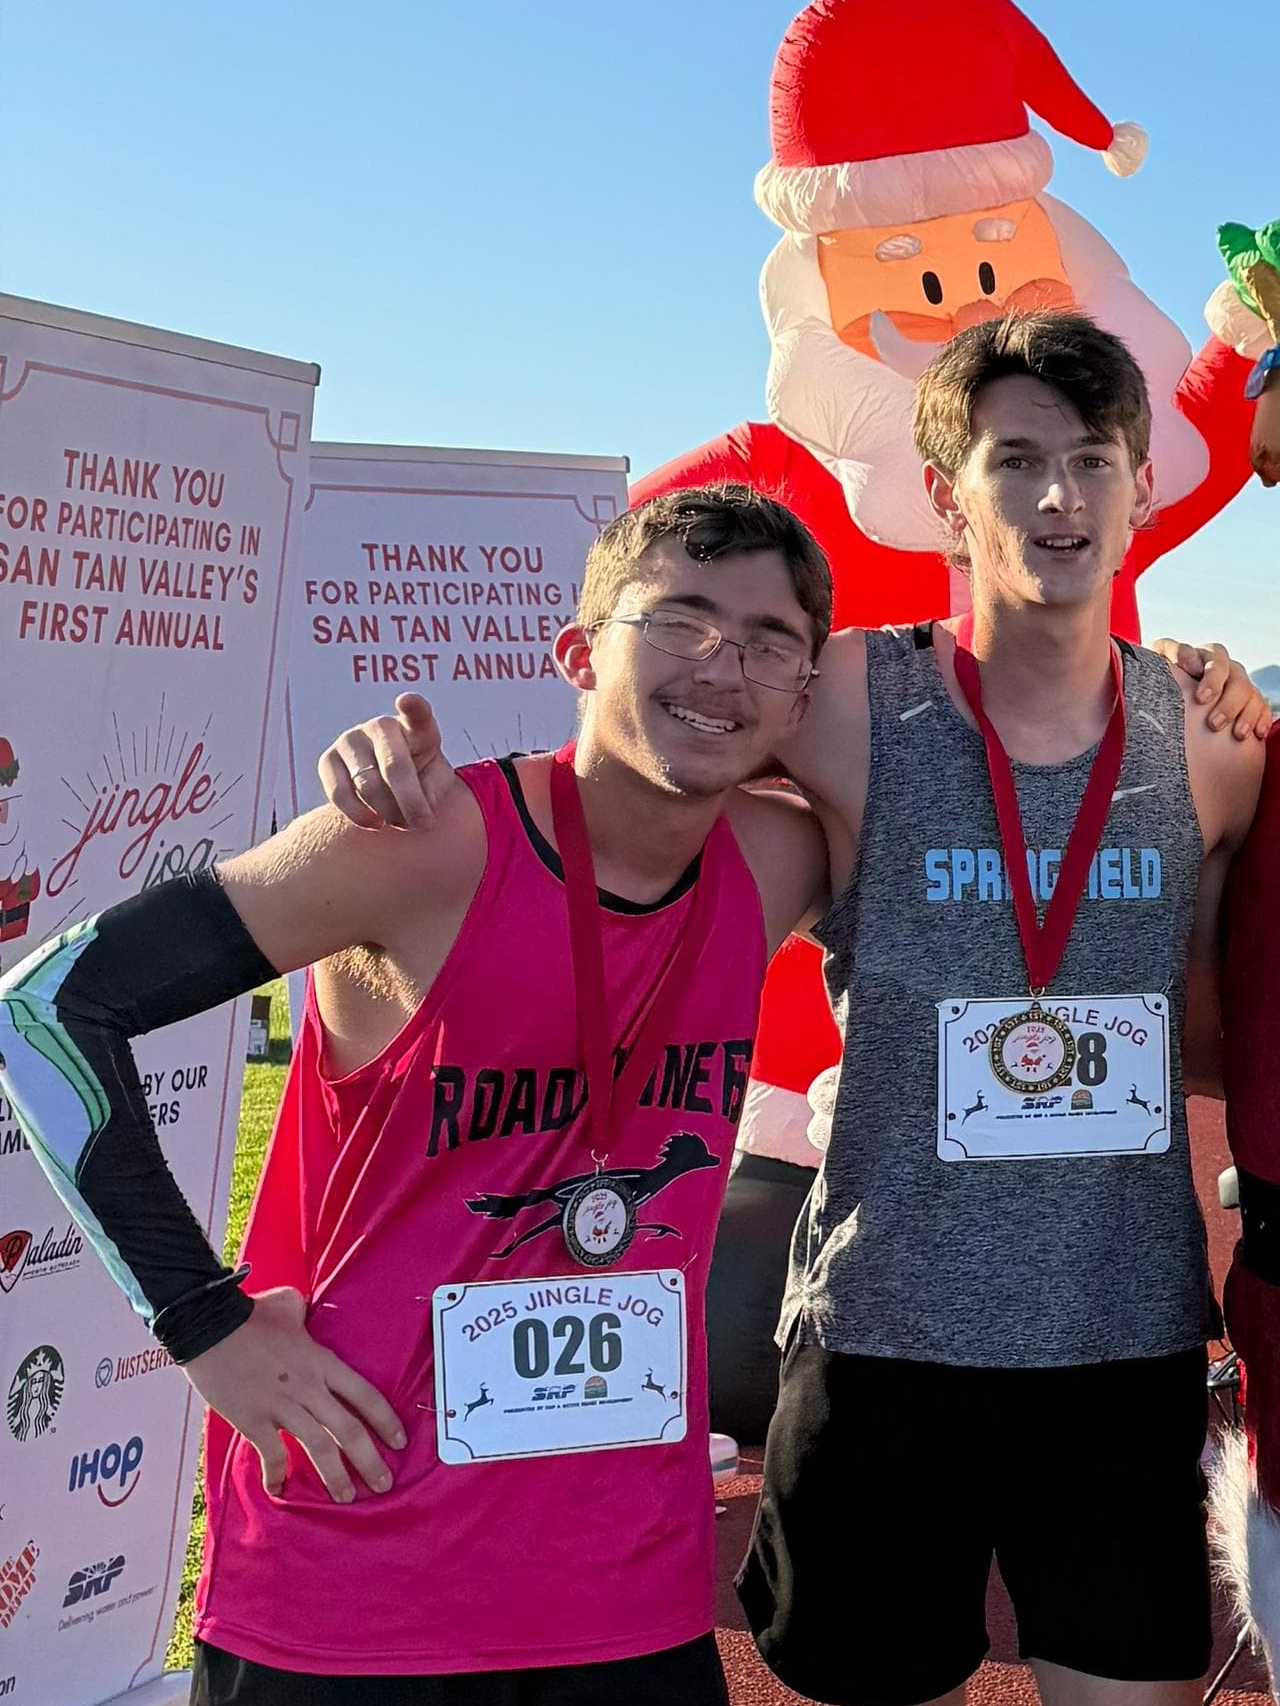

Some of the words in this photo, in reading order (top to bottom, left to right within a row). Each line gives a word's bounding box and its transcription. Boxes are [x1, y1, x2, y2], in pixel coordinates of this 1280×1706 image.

[64, 448, 161, 500] THANK
[172, 466, 224, 508] YOU
[57, 501, 231, 553] PARTICIPATING
[239, 525, 261, 556] IN
[72, 550, 127, 593] TAN
[140, 557, 259, 604] VALLEY'S
[361, 543, 469, 573] THANK
[479, 545, 544, 574] YOU
[305, 580, 359, 606] FOR
[368, 580, 562, 606] PARTICIPATING
[19, 600, 109, 644] FIRST
[114, 608, 224, 651] ANNUAL
[312, 615, 380, 644] SAN
[390, 615, 451, 643] TAN
[462, 615, 572, 643] VALLEY
[352, 654, 439, 683] FIRST
[452, 653, 558, 681] ANNUA
[46, 742, 216, 897] jingle
[924, 847, 1162, 902] SPRGIELD
[963, 1017, 1010, 1053] 202
[1104, 1016, 1149, 1047] JOG
[143, 1071, 166, 1096] BY
[171, 1065, 208, 1092] OUR
[461, 1300, 518, 1342] 2025
[524, 1286, 613, 1312] JINGLE
[617, 1295, 664, 1327] JOG
[513, 1312, 622, 1380] 026
[531, 1384, 576, 1401] SRP
[69, 1436, 144, 1492] IHOP
[62, 1555, 126, 1608] SRP
